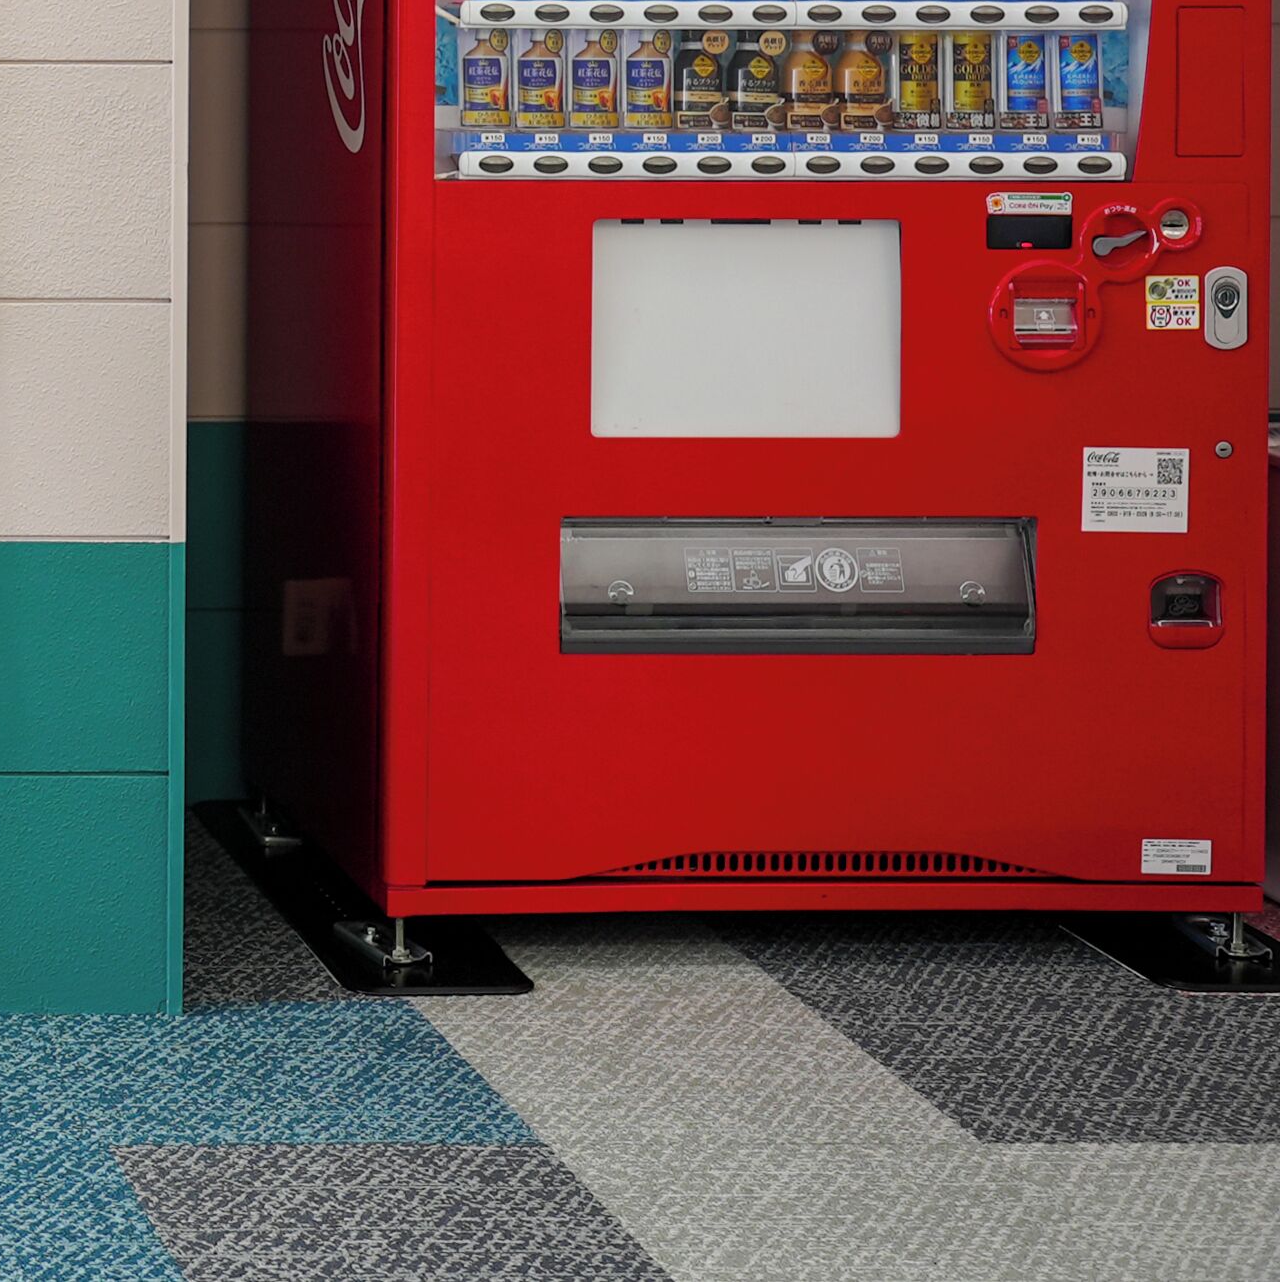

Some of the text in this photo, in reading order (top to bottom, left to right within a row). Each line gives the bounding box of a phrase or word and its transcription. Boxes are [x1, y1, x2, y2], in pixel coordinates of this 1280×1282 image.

[1040, 202, 1053, 210] Pay
[1177, 279, 1191, 287] OK
[1177, 317, 1192, 326] OK
